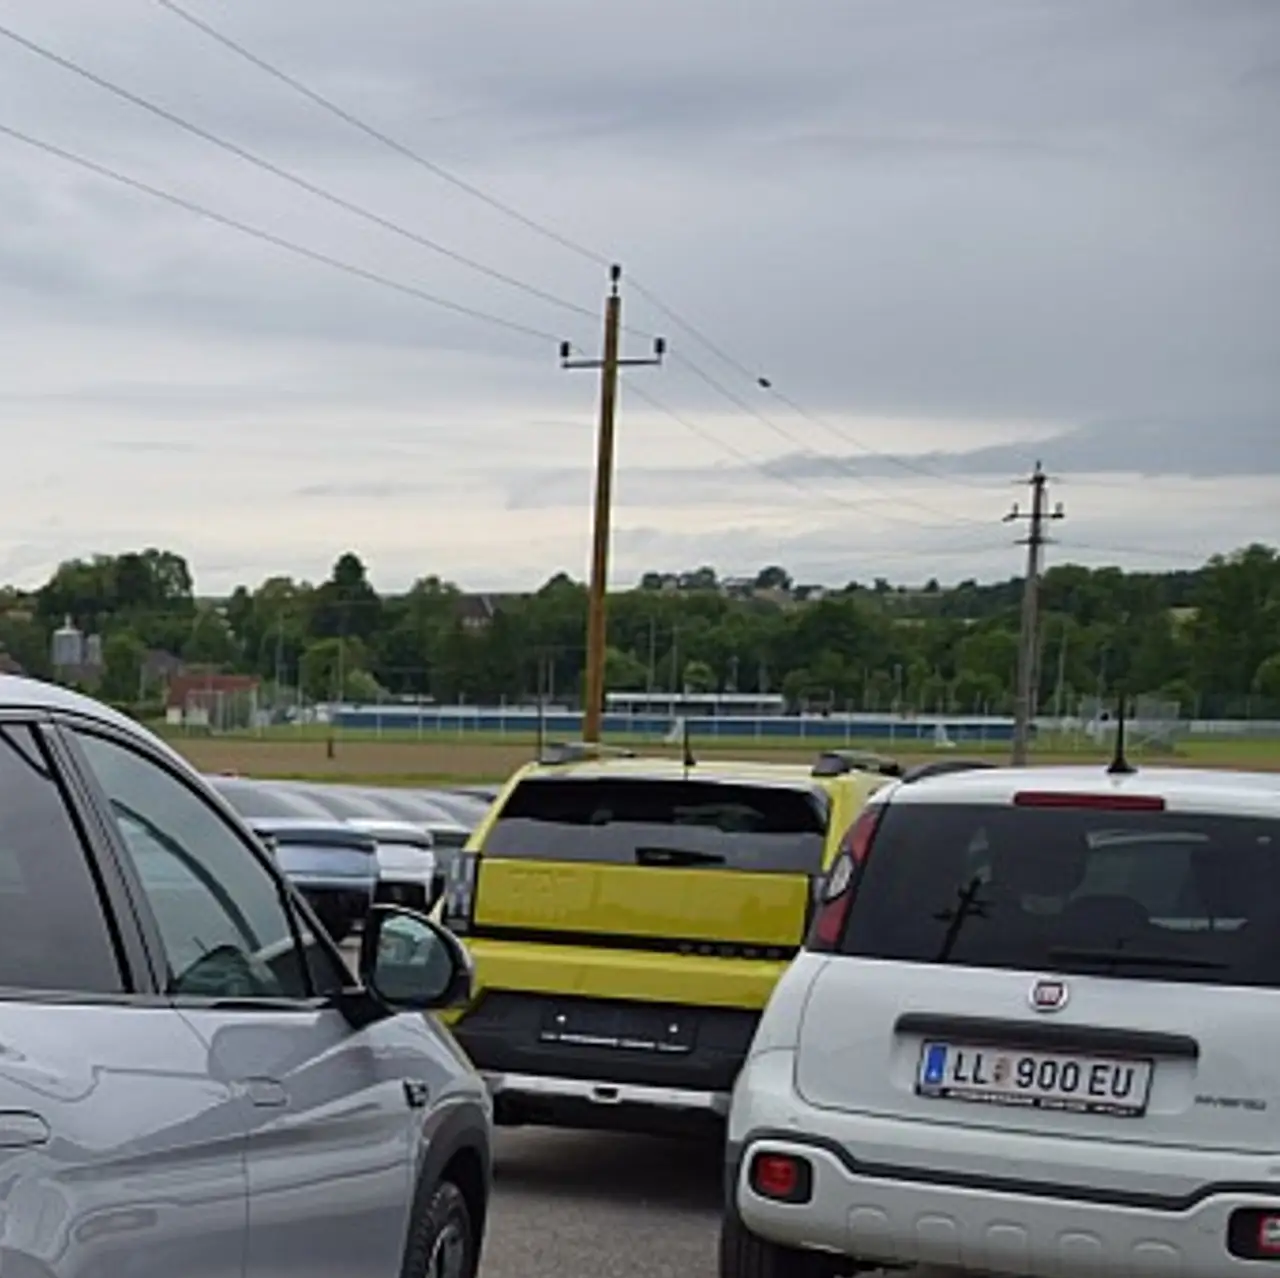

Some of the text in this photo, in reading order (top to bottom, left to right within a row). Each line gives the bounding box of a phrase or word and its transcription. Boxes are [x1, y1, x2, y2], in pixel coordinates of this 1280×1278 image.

[953, 1053, 1135, 1098] LL 900 EU
